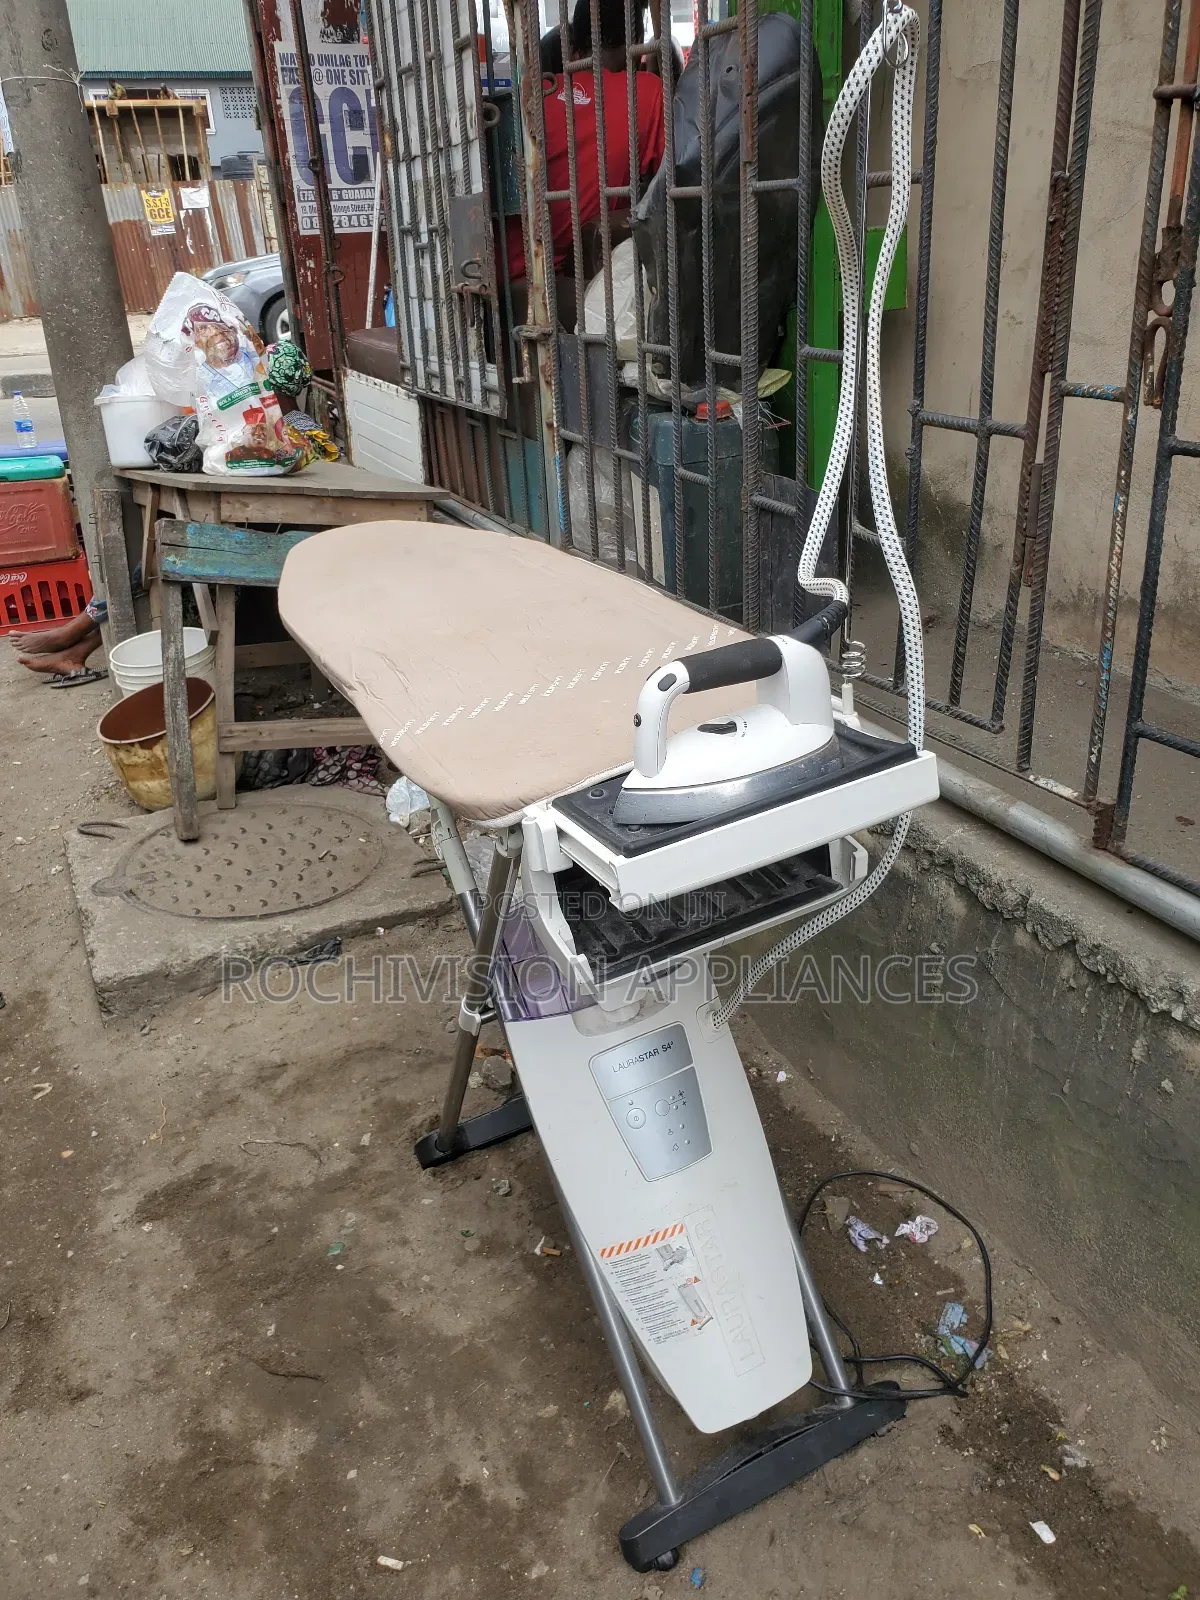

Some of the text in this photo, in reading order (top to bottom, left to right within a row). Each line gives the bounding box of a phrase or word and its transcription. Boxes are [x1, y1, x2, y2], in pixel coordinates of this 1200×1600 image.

[317, 53, 352, 68] UNILAG
[353, 54, 370, 68] TUT
[281, 66, 371, 86] PAS @ ONE SIT
[149, 208, 172, 219] GCE
[612, 1048, 660, 1073] LAURASTAR
